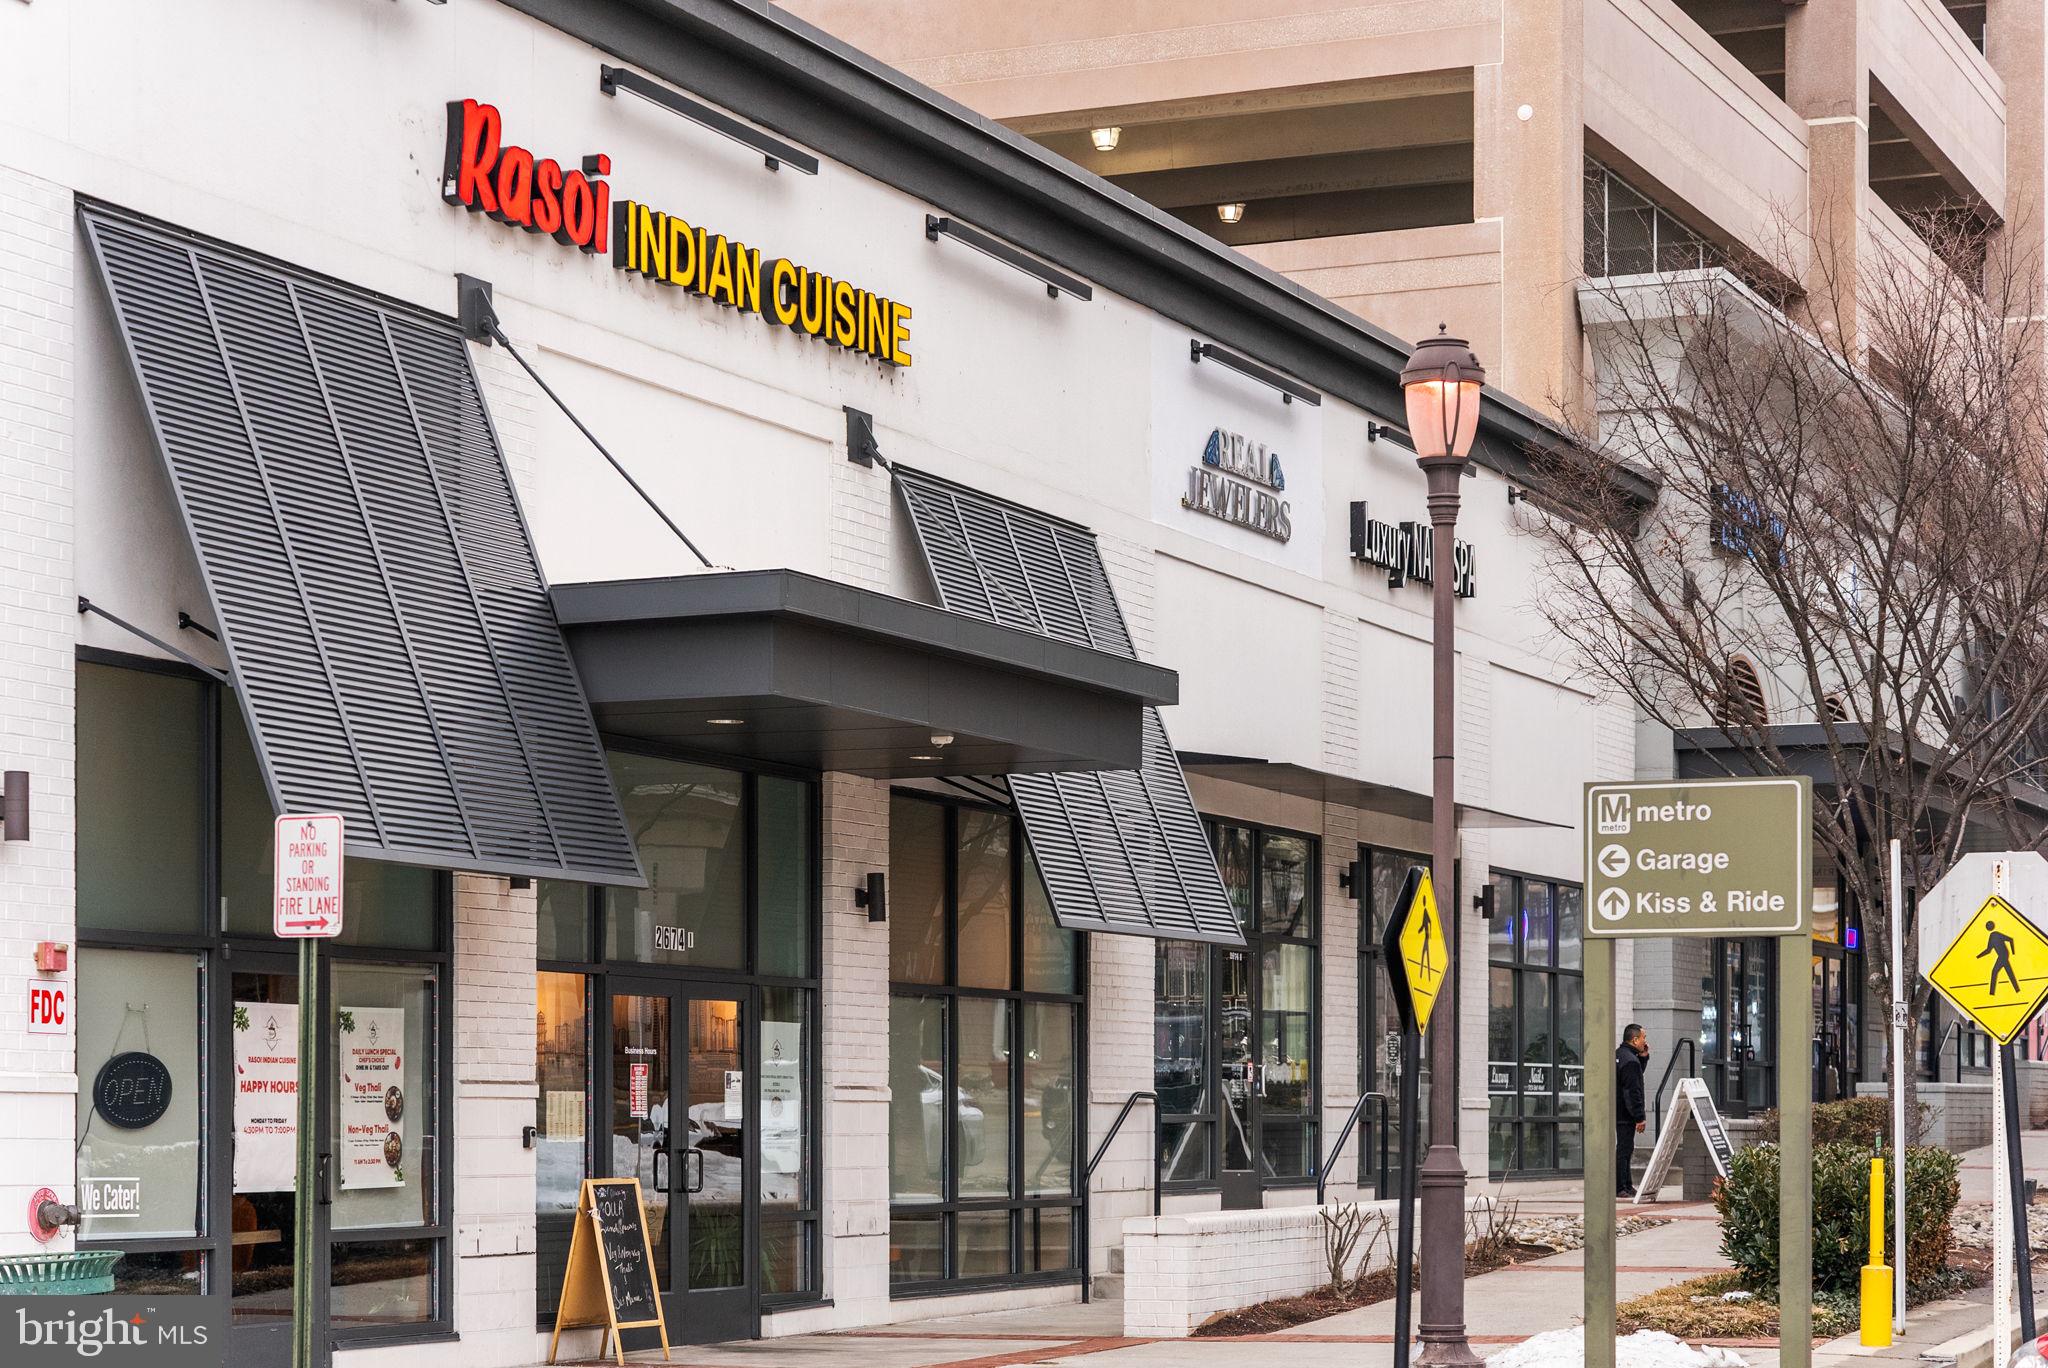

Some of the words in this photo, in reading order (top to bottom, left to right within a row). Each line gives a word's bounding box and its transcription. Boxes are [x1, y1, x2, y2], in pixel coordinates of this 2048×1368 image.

[448, 99, 610, 254] Rasoi
[616, 200, 761, 314] INDIAN
[762, 258, 913, 367] CUISINE
[1184, 466, 1292, 543] JEWELERS
[1350, 501, 1411, 588] Luxury
[1454, 538, 1477, 598] SPA
[1601, 796, 1627, 822] M
[1637, 801, 1711, 822] metro
[301, 826, 316, 840] NO
[1601, 824, 1627, 832] metro
[289, 843, 327, 857] PARKING
[1636, 849, 1729, 873] Garage
[302, 860, 314, 874] OR
[286, 877, 329, 892] STANDING
[280, 897, 303, 915] FIRE
[309, 897, 338, 915] LANE
[1637, 892, 1690, 913] Kiss
[1700, 891, 1717, 912] &
[1727, 890, 1785, 912] Ride
[656, 926, 685, 950] 2674
[31, 989, 65, 1025] FDC
[625, 1046, 644, 1055] Business
[644, 1047, 657, 1055] Hours
[240, 1080, 268, 1093] HAPPY
[354, 1083, 367, 1094] Veg
[367, 1083, 382, 1092] Thali
[1529, 1067, 1545, 1084] Nails
[1564, 1070, 1578, 1091] Spa
[105, 1078, 163, 1106] OPEN
[265, 1126, 274, 1134] TO
[274, 1126, 296, 1134] 7:00PM
[347, 1124, 373, 1135] Non-Veg
[374, 1124, 389, 1133] Thali
[81, 1184, 101, 1211] We
[103, 1183, 140, 1211] Cater!
